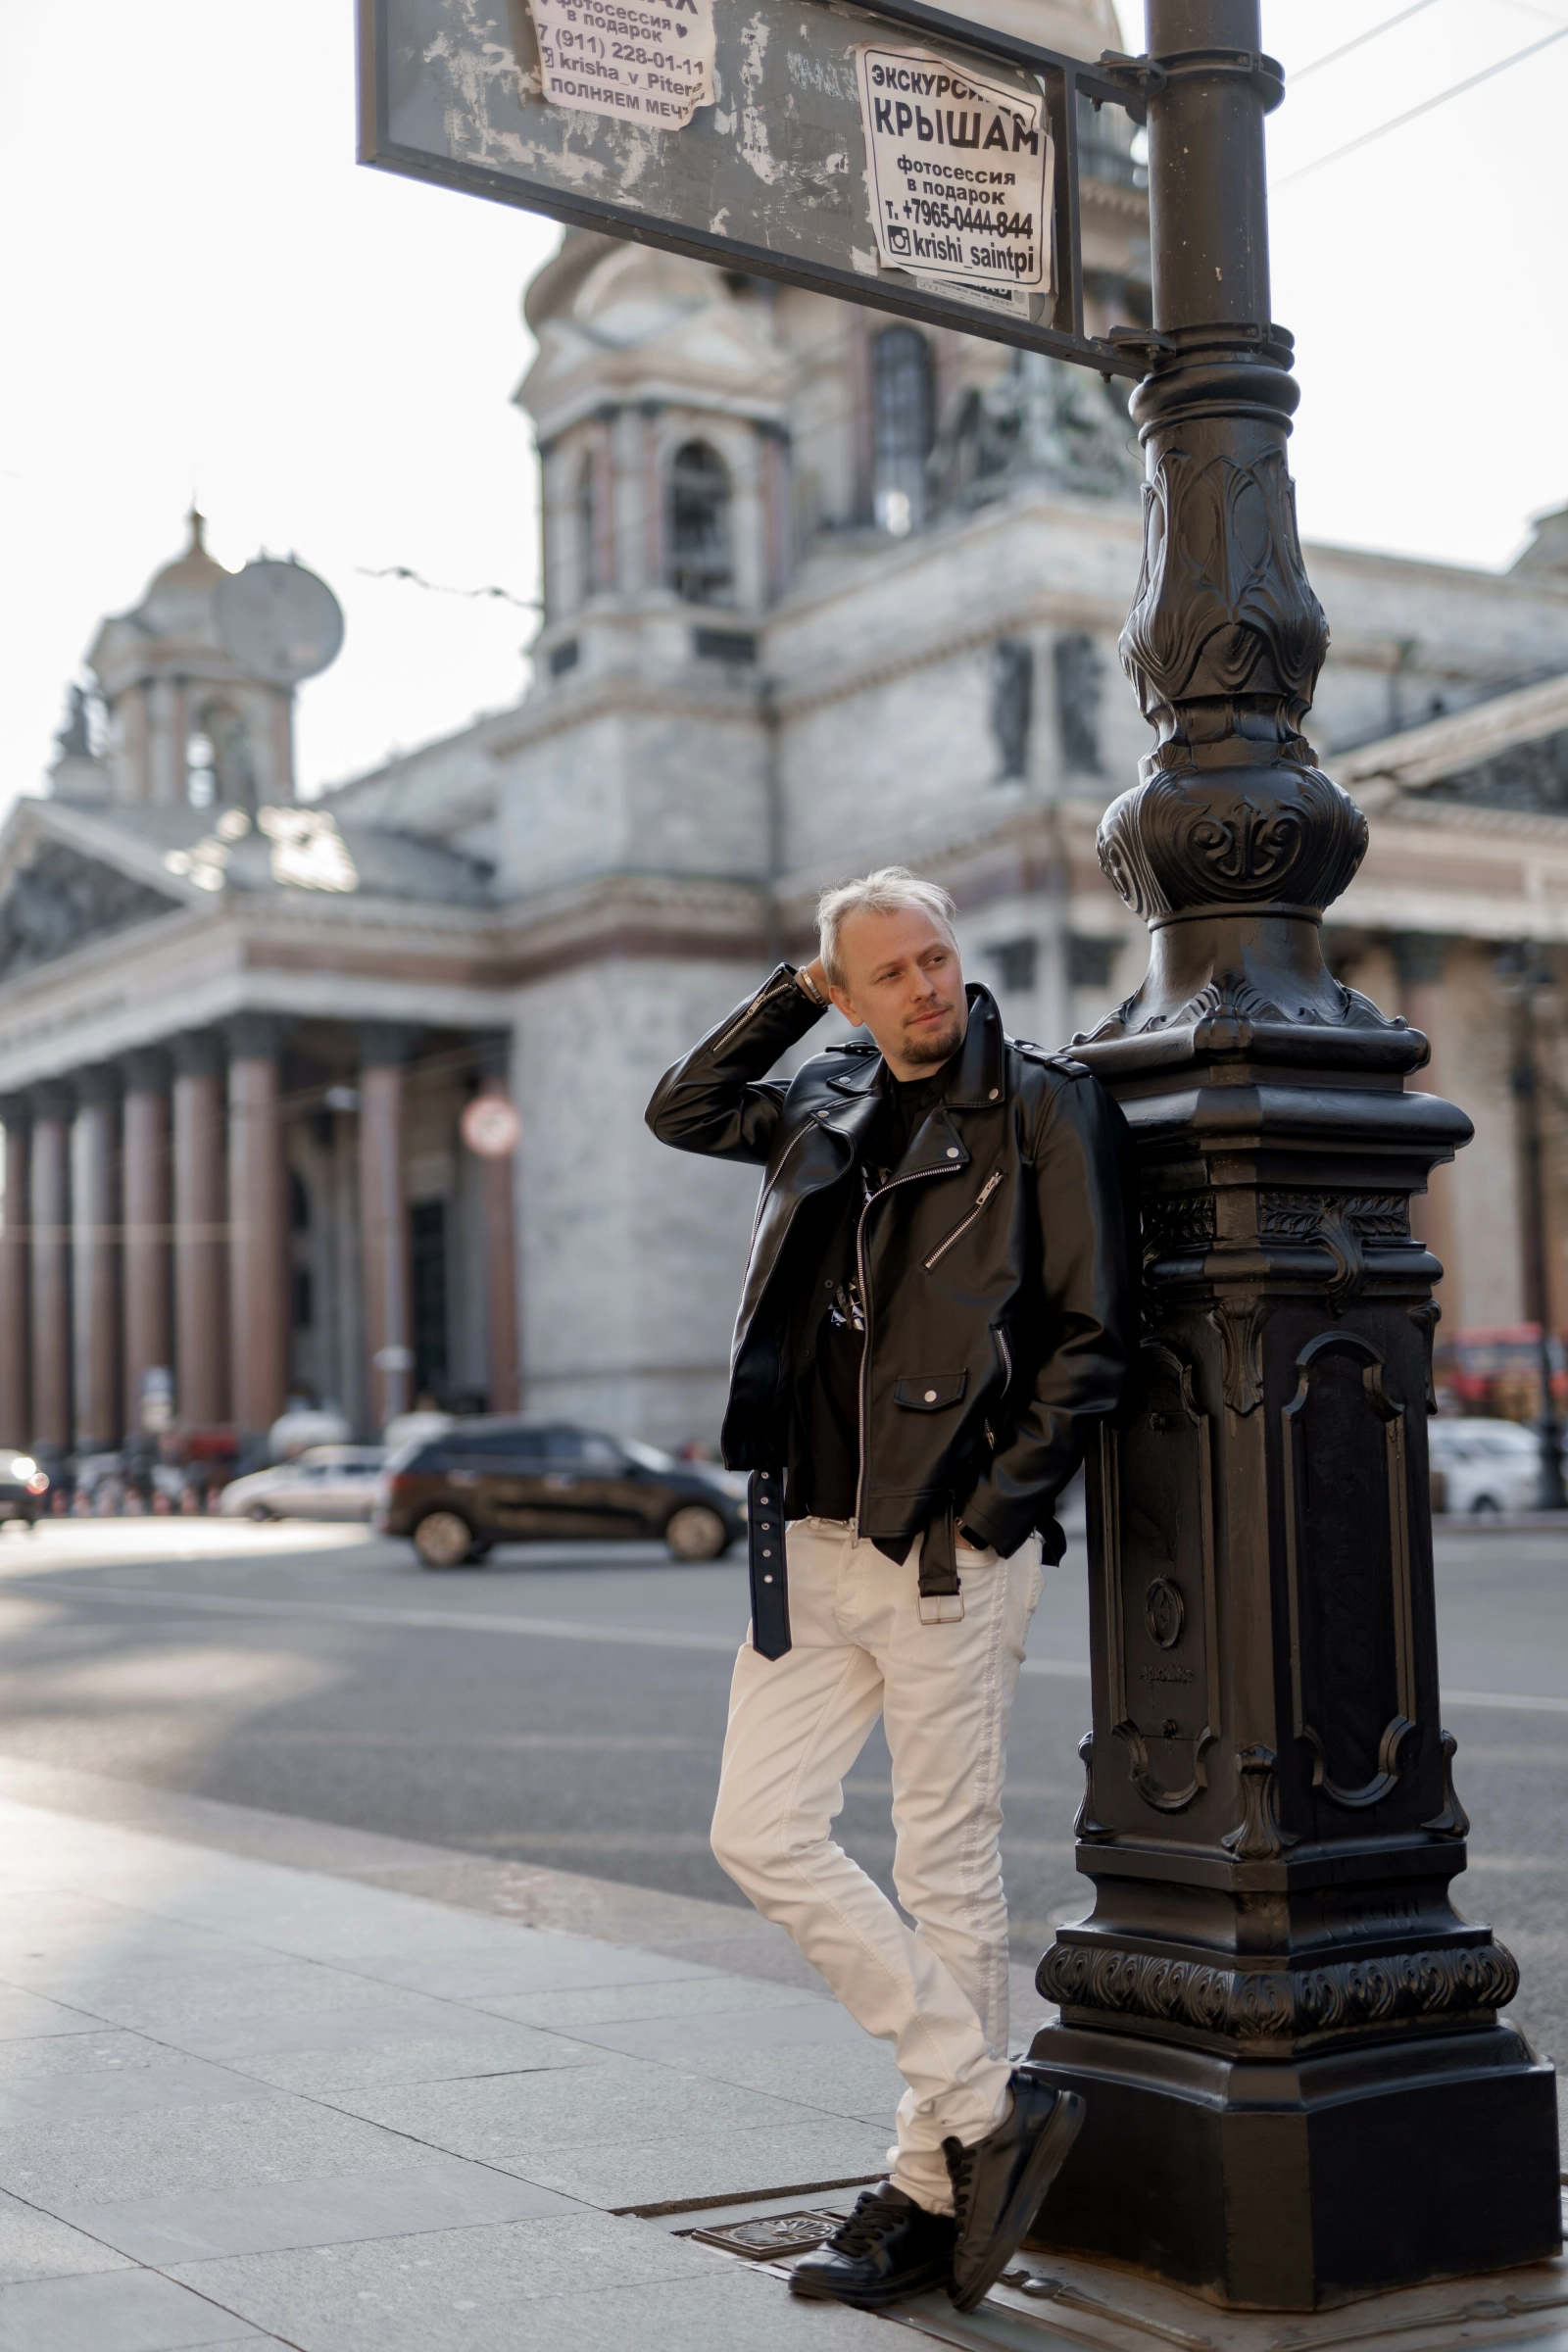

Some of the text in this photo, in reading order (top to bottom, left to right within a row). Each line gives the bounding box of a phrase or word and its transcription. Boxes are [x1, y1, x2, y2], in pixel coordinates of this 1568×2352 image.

[566, 9, 662, 43] в подарок
[555, 28, 605, 59] (911)
[612, 42, 704, 75] 228-01-11
[560, 52, 704, 97] krisha_v_Pitere
[871, 64, 991, 104] ЭКСКУРСИ
[874, 97, 1039, 156] КРЫШАМ
[897, 154, 1016, 185] фотосессия
[907, 178, 1004, 205] в подарок
[903, 198, 1033, 239] +7965-0444-844
[912, 229, 1034, 278] krishi_saintpi
